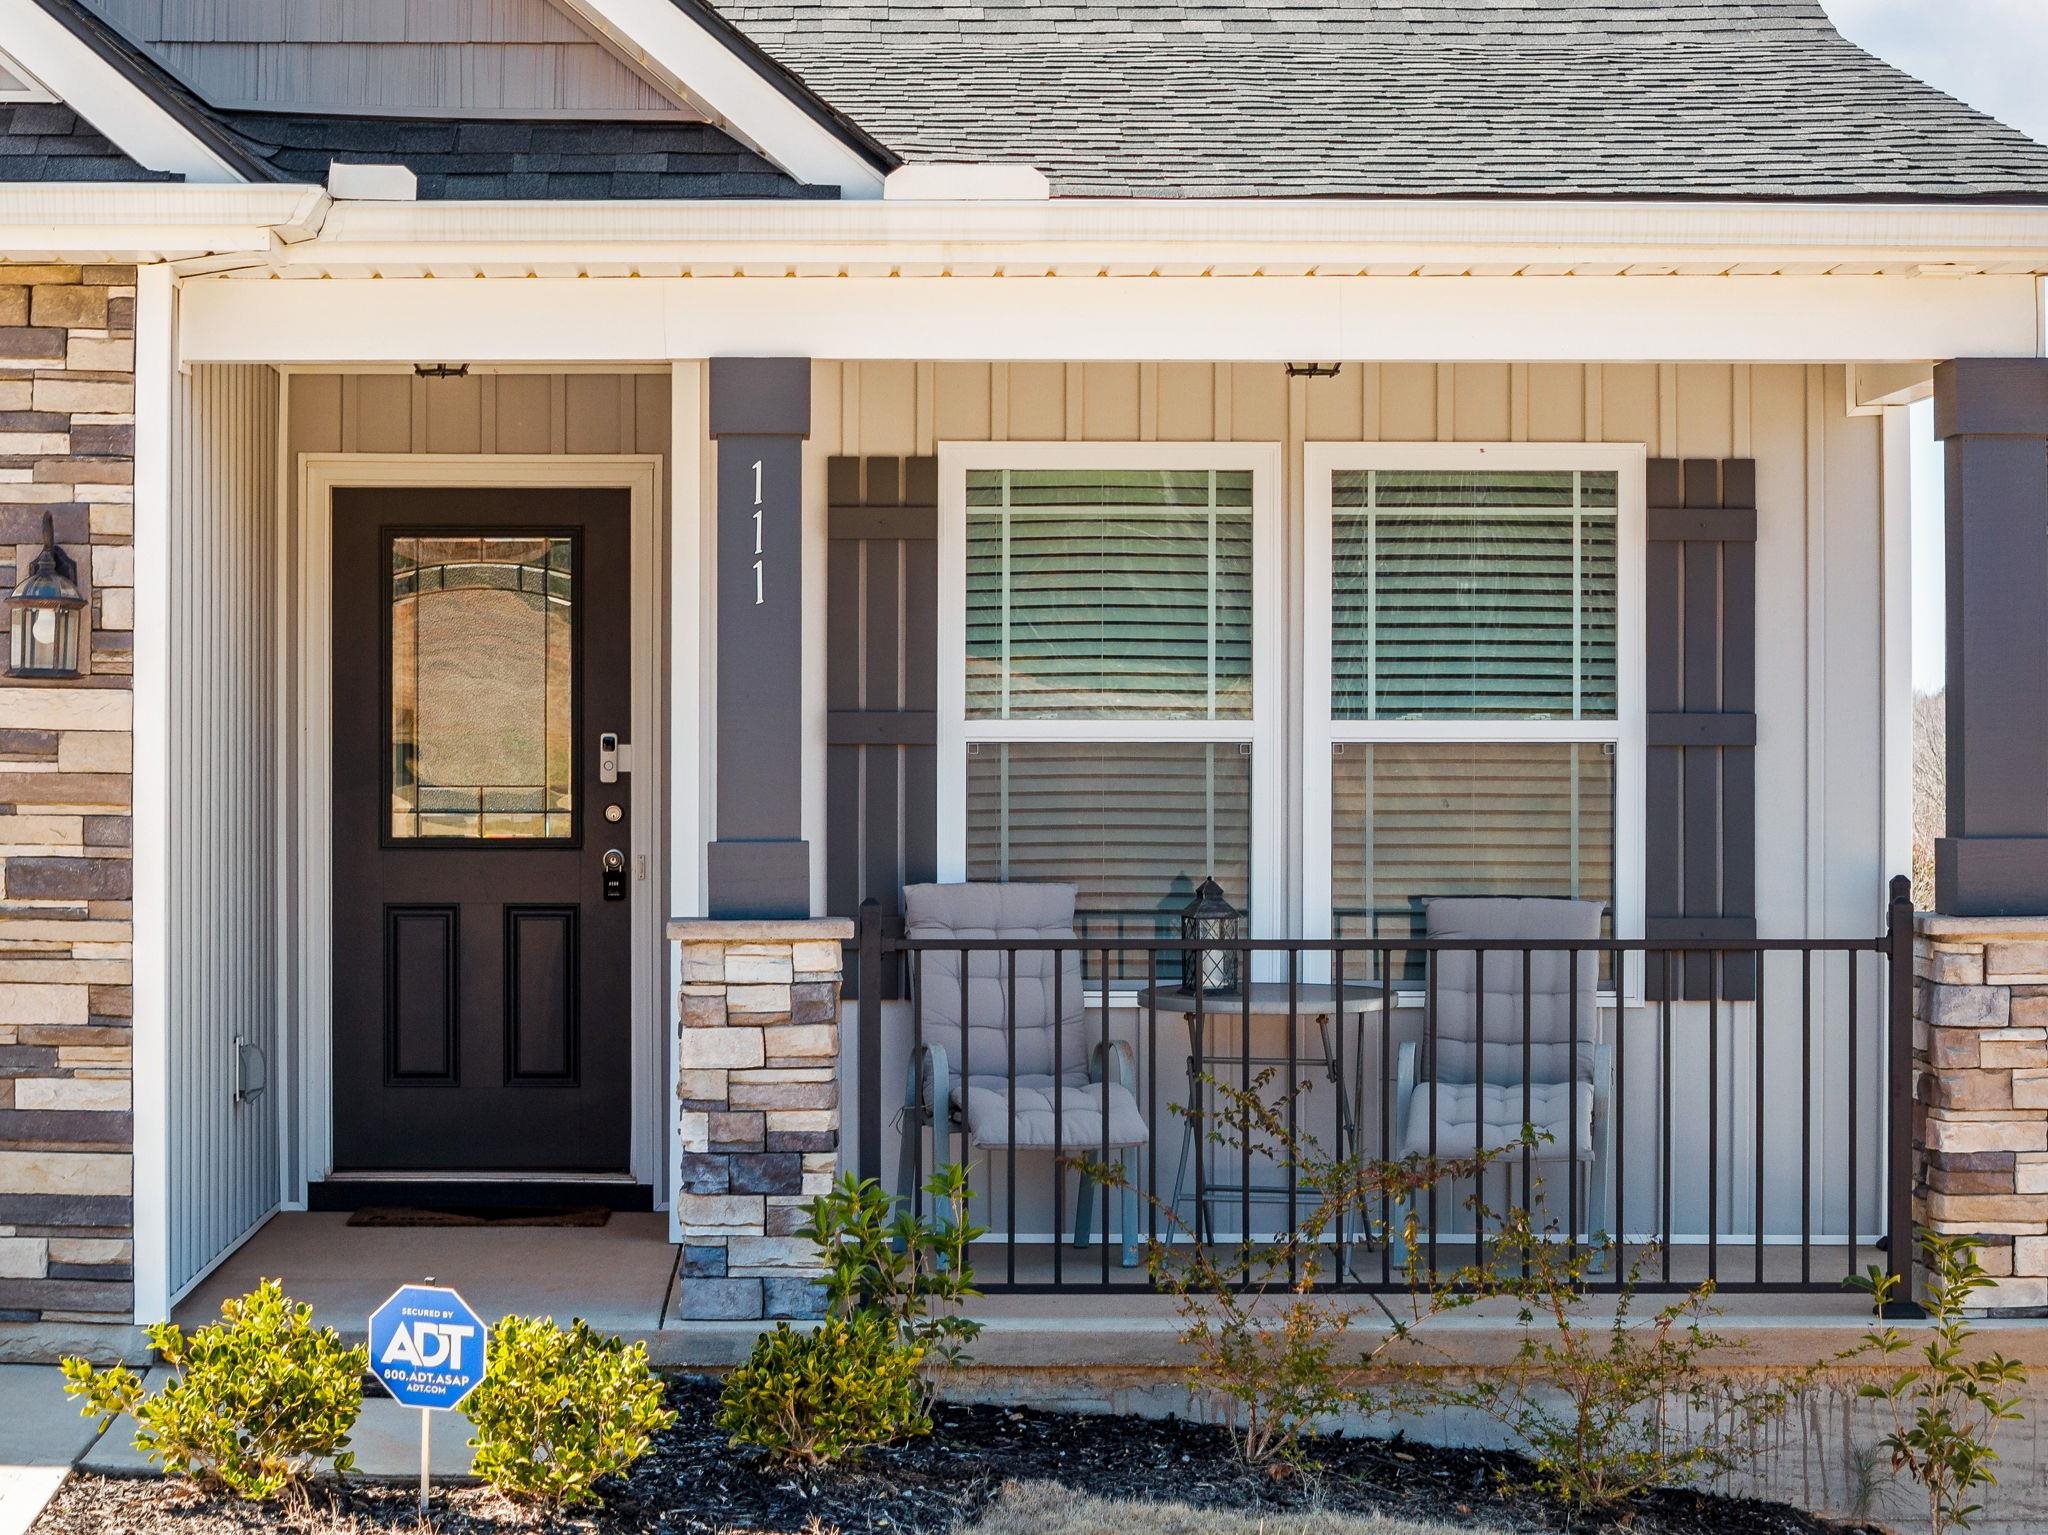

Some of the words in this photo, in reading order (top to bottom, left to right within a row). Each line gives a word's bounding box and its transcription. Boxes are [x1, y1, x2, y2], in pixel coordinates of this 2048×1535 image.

[752, 460, 764, 605] 111
[401, 1307, 441, 1318] SECURED
[442, 1310, 454, 1319] BY
[380, 1321, 475, 1370] ADT
[384, 1368, 470, 1387] 800.ADT.ASAP
[406, 1384, 447, 1395] ADT.COM
